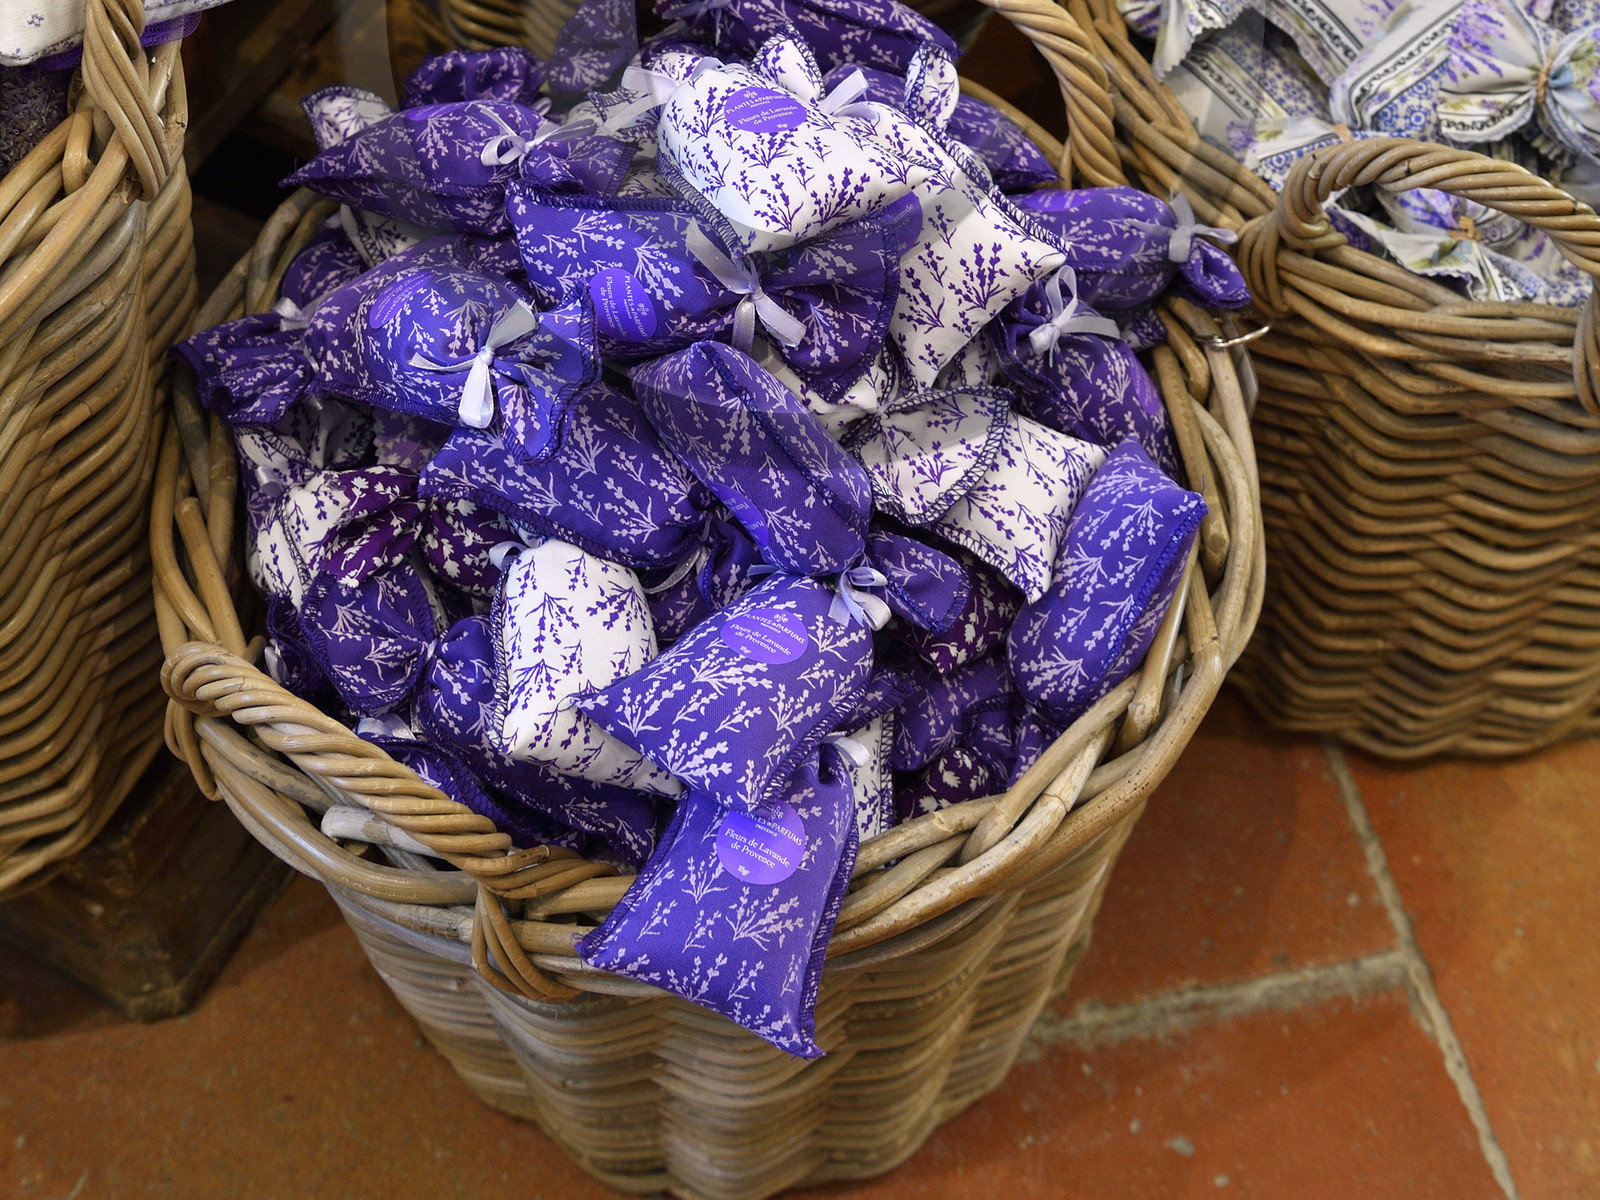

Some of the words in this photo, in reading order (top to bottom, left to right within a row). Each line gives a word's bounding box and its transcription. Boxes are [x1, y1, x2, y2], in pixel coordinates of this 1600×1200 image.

[726, 100, 755, 114] PLANTES
[758, 95, 787, 103] PARFUMS
[738, 114, 760, 125] Fleurs
[769, 105, 798, 114] Lavande
[762, 111, 794, 121] Provence
[892, 204, 915, 223] avande
[600, 286, 607, 297] de
[602, 298, 615, 329] Provence
[610, 300, 616, 309] de
[625, 276, 634, 306] PLANTES
[632, 311, 648, 337] PARFUMS
[612, 310, 627, 337] Lavande
[730, 623, 751, 634] Fleurs
[762, 634, 791, 656] Lavande
[743, 613, 772, 625] PLANTES
[775, 623, 806, 644] PARFUMS
[745, 633, 777, 654] Provence
[755, 823, 778, 837] PROVENCE
[771, 822, 804, 846] PARFUMS
[725, 828, 747, 843] Fleurs
[748, 838, 758, 848] de
[758, 843, 790, 867] Lavande
[731, 841, 741, 850] de
[741, 845, 776, 868] Provence
